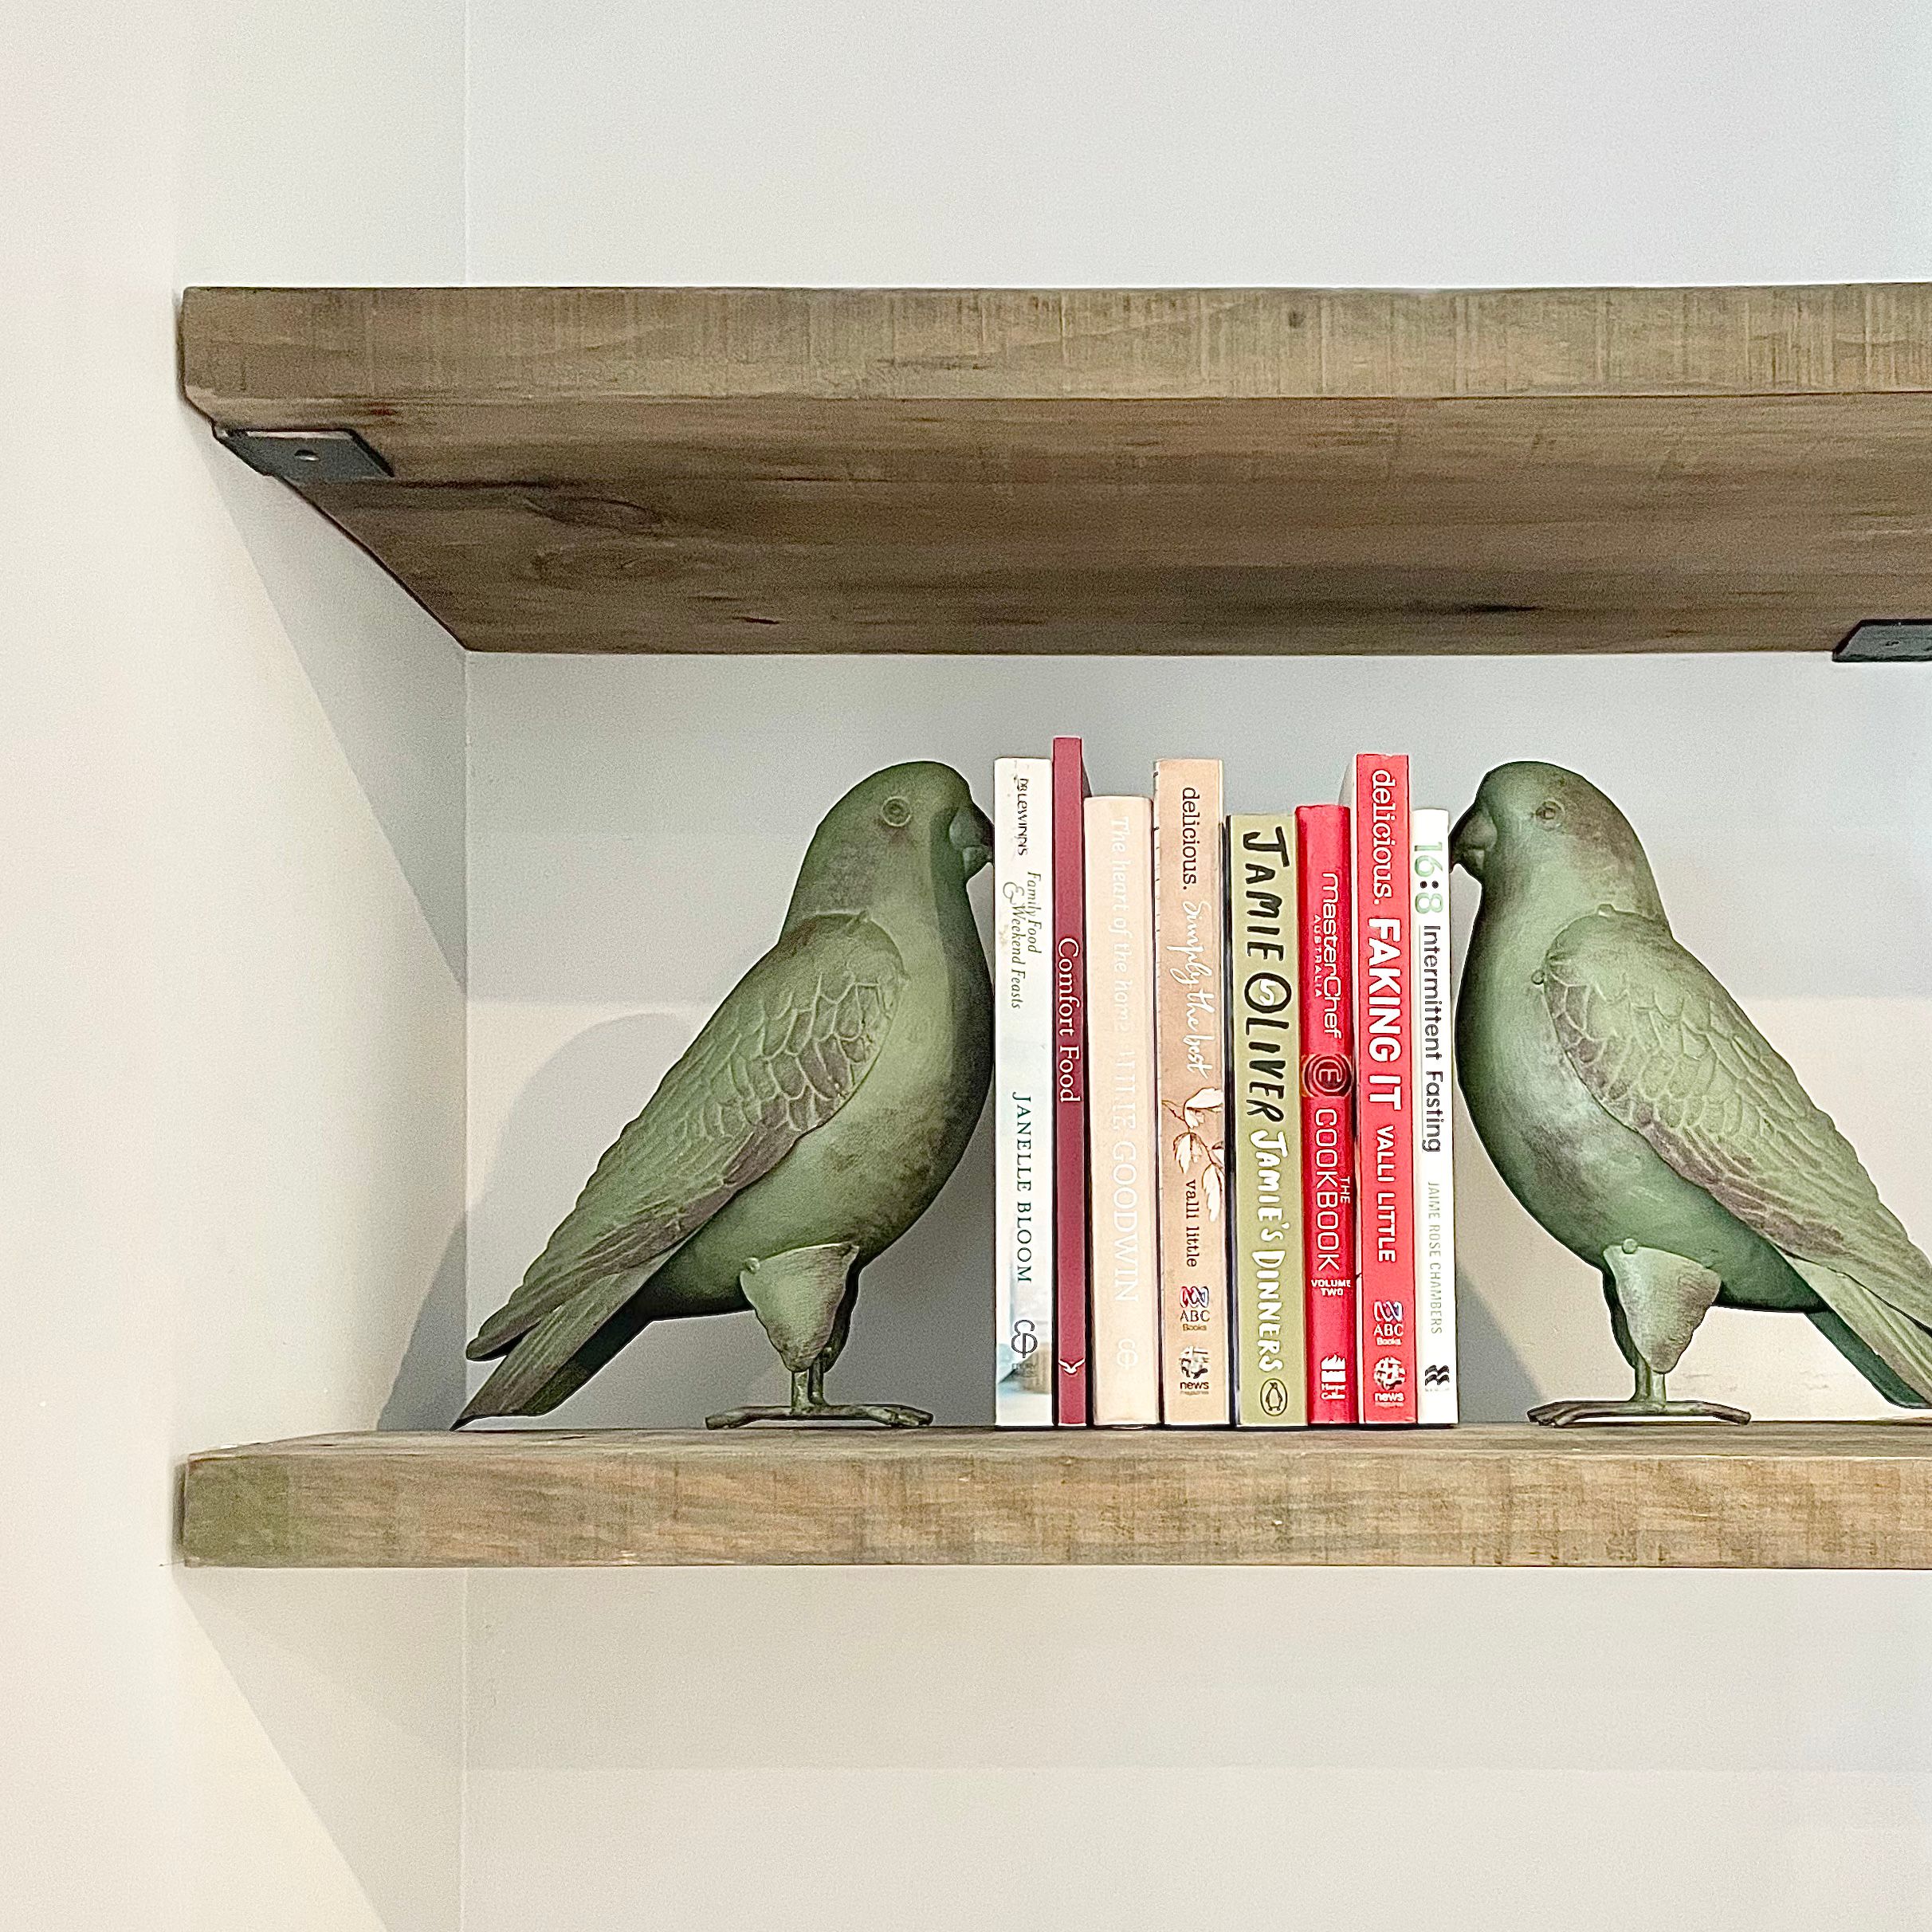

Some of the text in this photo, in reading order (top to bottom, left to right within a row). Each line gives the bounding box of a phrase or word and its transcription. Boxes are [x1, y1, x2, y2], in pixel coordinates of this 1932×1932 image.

[1110, 816, 1130, 852] The
[1181, 786, 1200, 891] delicious.
[1371, 768, 1397, 905] delicious.
[1027, 871, 1043, 954] Family Food
[1108, 917, 1133, 940] of
[1110, 858, 1133, 911] heart
[1002, 882, 1027, 1010] & Weekend Feasts
[1113, 942, 1133, 974] the
[1166, 899, 1216, 1080] Simply the best
[1242, 825, 1293, 1122] JAMIE OLIVER
[1314, 914, 1323, 998] AUSTRALIA
[1058, 937, 1082, 1103] Comfort Food
[1367, 917, 1403, 1111] FAKING IT
[1413, 841, 1444, 1153] 16:8 Intermittent Fasting
[1011, 1091, 1033, 1283] JANELLE BLOOM
[1112, 1140, 1140, 1302] GOODWIN
[1184, 1179, 1200, 1268] valli little
[1314, 1108, 1341, 1271] COOKBOOK
[1339, 1175, 1352, 1205] THE
[1376, 1125, 1396, 1263] VALLI LITTLE
[1249, 1129, 1291, 1373] JAMIE'S DINNERS
[1310, 1278, 1352, 1288] VOLUME
[1320, 1288, 1345, 1297] TWO
[1427, 1180, 1443, 1336] JAIME ROSE CHAMBERS
[1179, 1309, 1211, 1323] ABC
[1372, 1322, 1404, 1337] ABC
[1179, 1380, 1210, 1391] news
[1374, 1391, 1405, 1403] news
